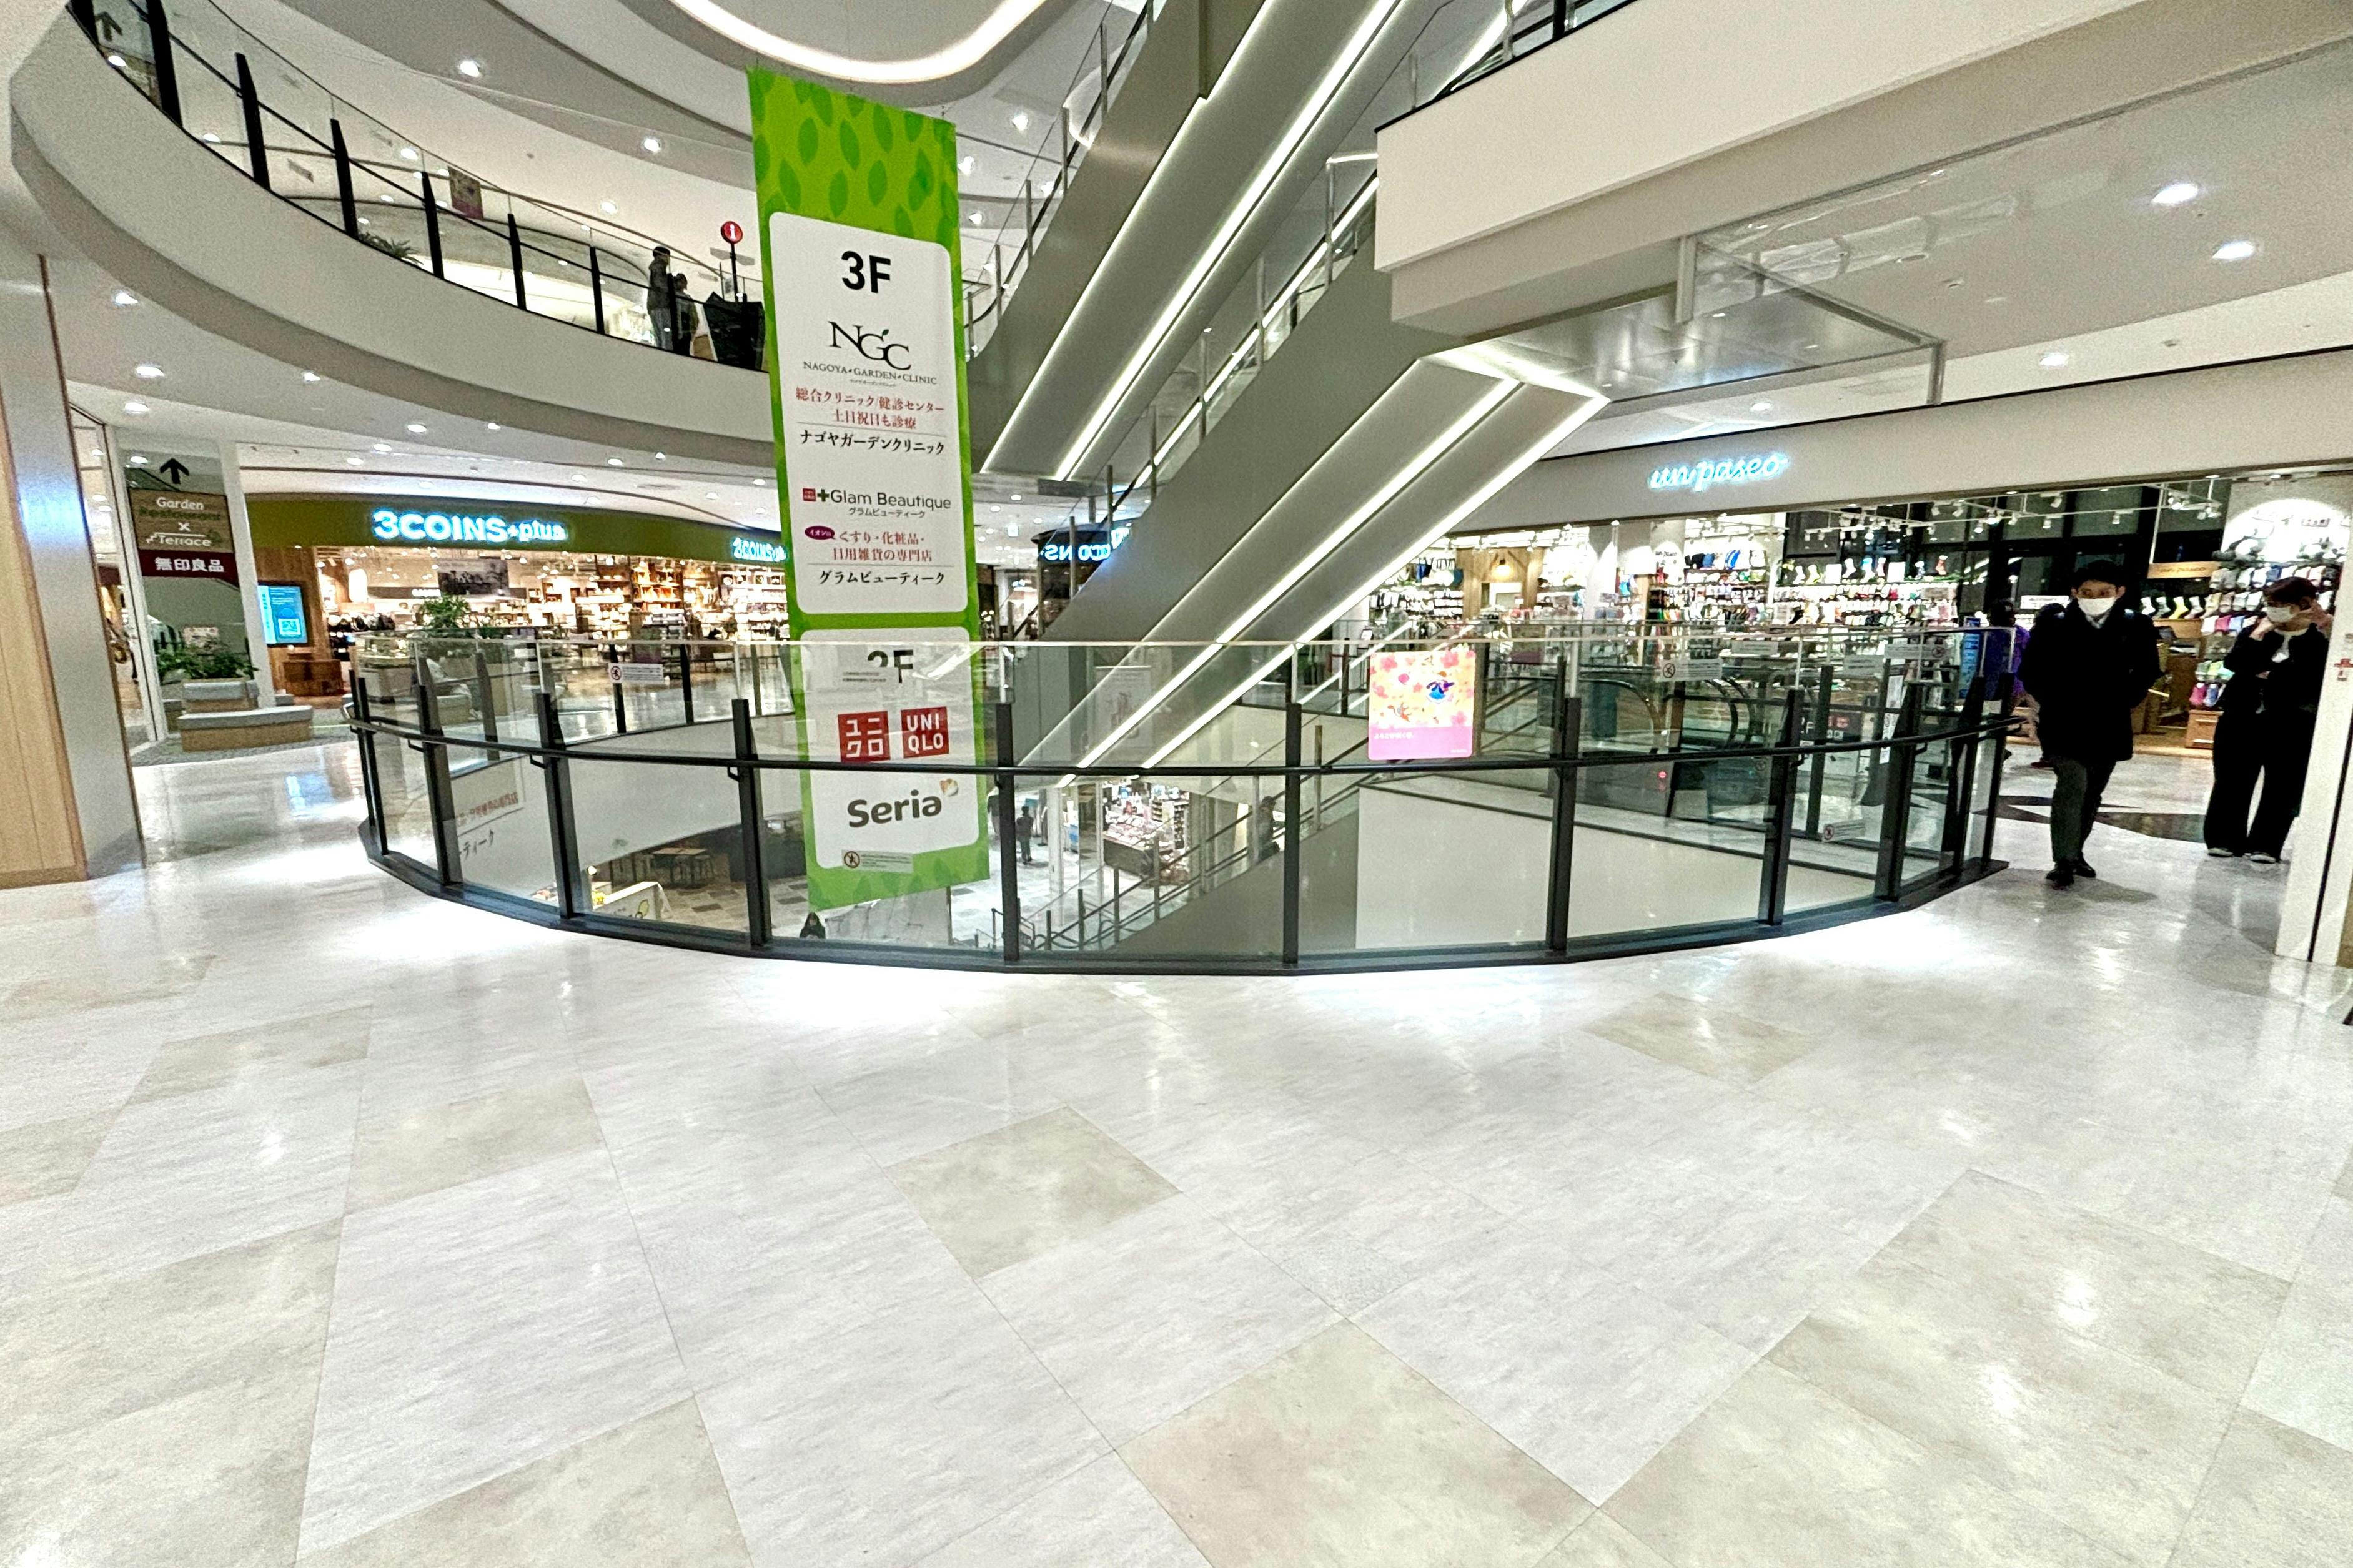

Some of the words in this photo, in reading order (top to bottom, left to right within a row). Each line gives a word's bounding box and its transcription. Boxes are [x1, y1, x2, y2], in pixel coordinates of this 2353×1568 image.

[841, 250, 891, 293] 3F
[828, 321, 911, 370] NGC
[833, 408, 916, 430] 土日祝日も診療
[800, 429, 945, 455] ナゴヤガーデンクリニック
[1693, 455, 1789, 492] paseo
[156, 496, 204, 510] Garden
[830, 490, 872, 505] Glam
[877, 492, 951, 511] Beautique
[848, 507, 926, 519] グラムビューティーク
[160, 535, 212, 547] Terrace
[154, 557, 225, 573] 無印良品
[833, 547, 933, 562] 日用雑貨の専門店
[819, 570, 945, 586] グラムビューティーク
[847, 789, 942, 828] Seria
